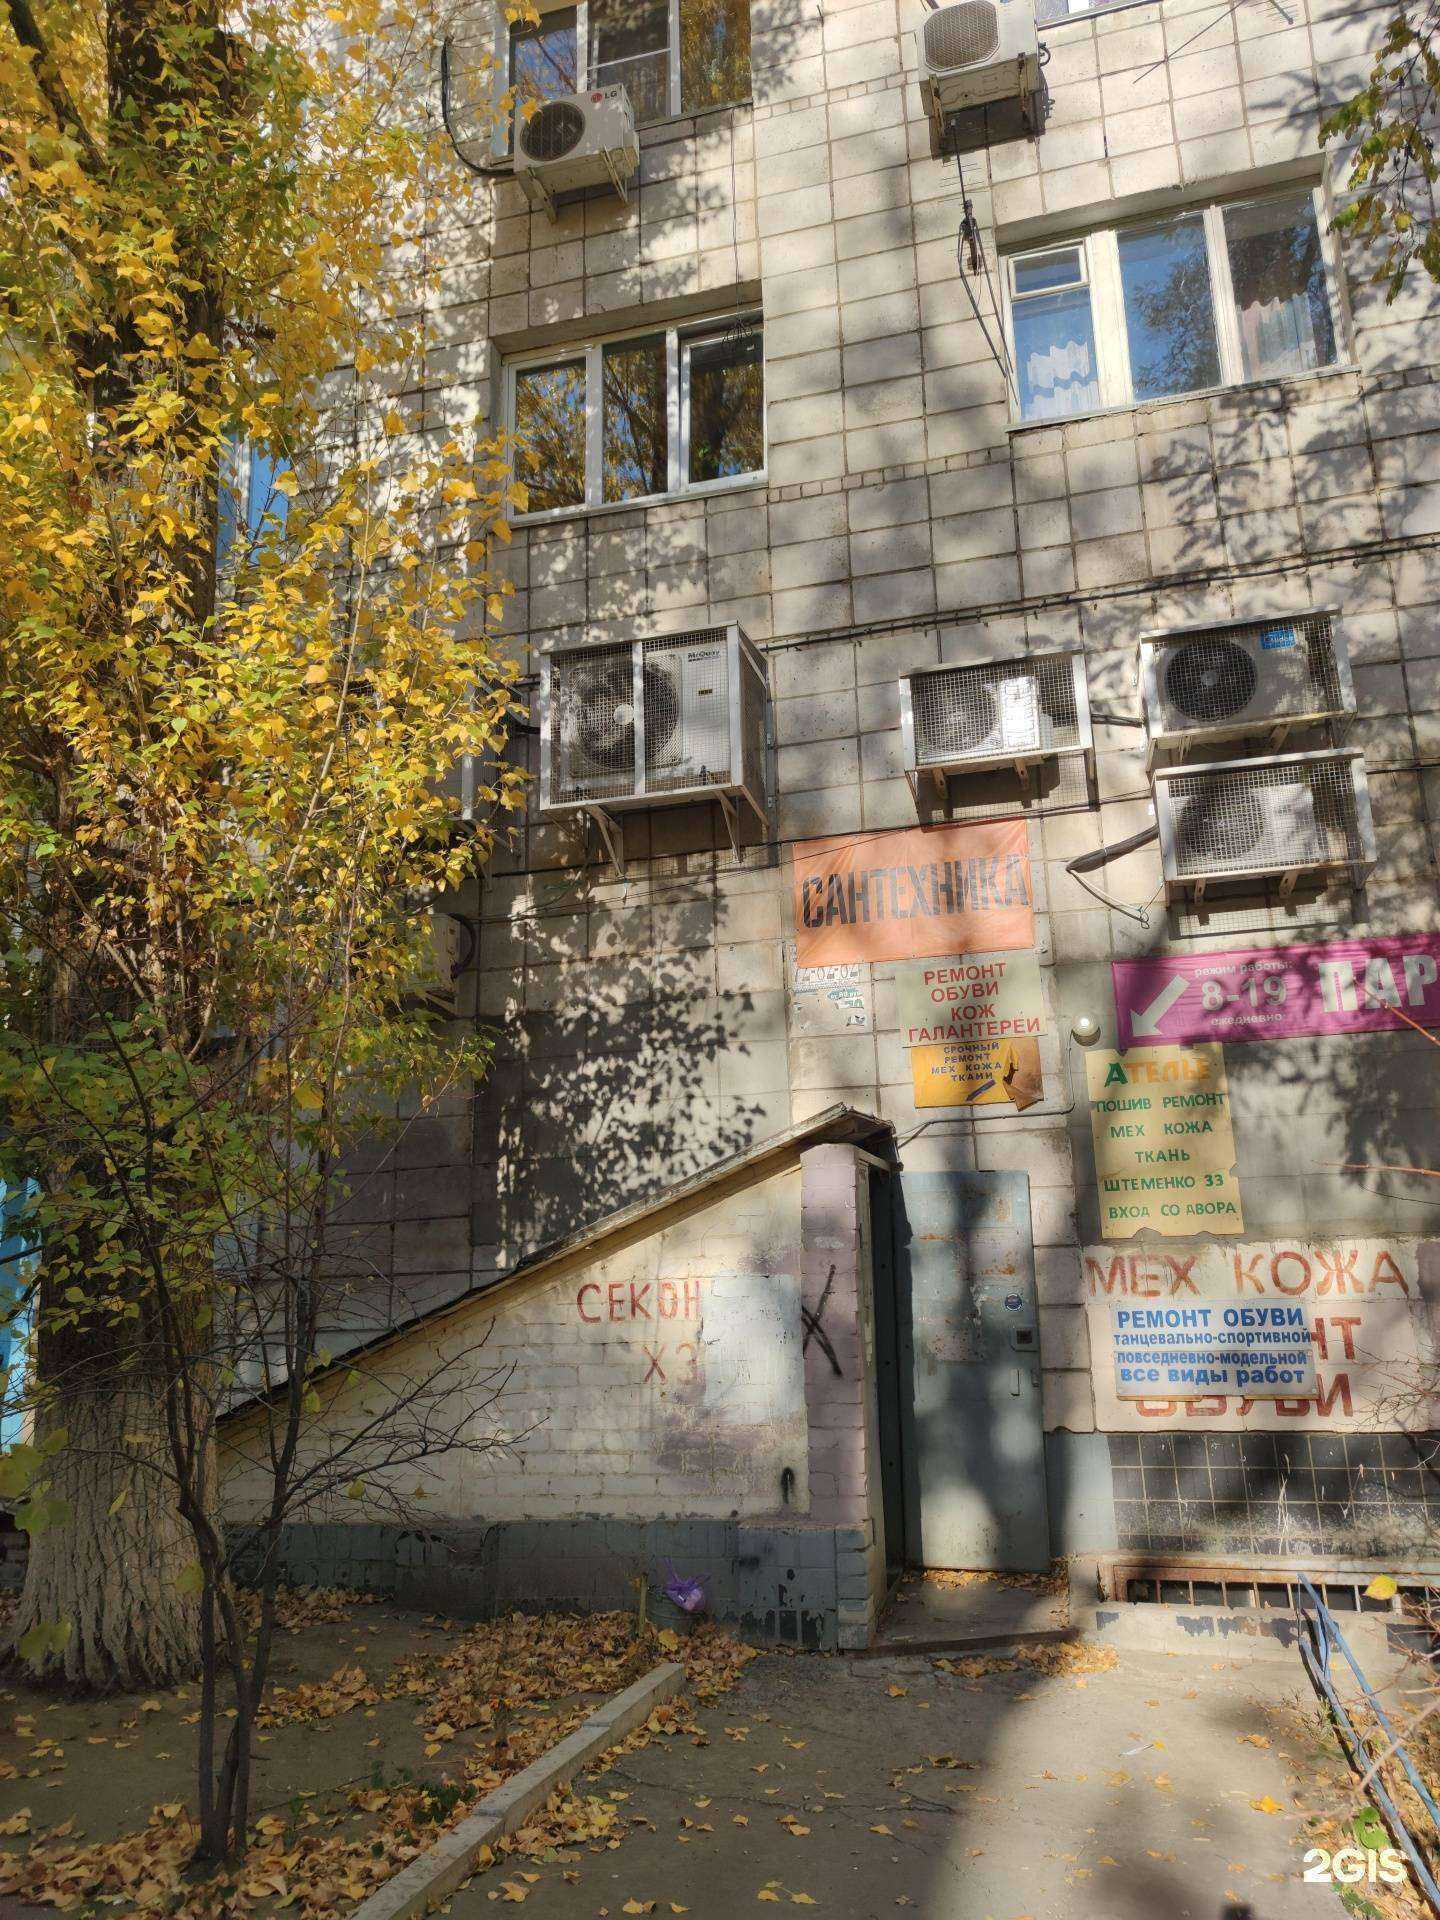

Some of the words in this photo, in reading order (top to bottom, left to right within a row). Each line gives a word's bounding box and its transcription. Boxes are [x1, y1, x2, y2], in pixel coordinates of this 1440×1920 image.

[604, 90, 618, 99] LG
[802, 853, 1028, 929] САНТЕХНИКА
[924, 962, 1006, 985] РЕМОНТ
[1318, 954, 1438, 1013] ПАР
[930, 981, 999, 1002] ОБУВИ
[1201, 975, 1287, 1011] 8-19
[951, 1003, 996, 1021] КОЖ
[1211, 1013, 1283, 1026] ежедневно
[908, 1018, 1041, 1042] ГАЛАНТЕРЕИ
[943, 1041, 1000, 1054] СРОЧНЫЙ
[931, 1064, 956, 1075] МЕХ
[965, 1061, 1002, 1072] КОЖА
[944, 1053, 991, 1063] РЕМОНТ
[951, 1071, 993, 1082] ТКАНИ
[1104, 1058, 1210, 1087] АТЕЛЬЕ
[1095, 1097, 1152, 1113] ПОШИВ
[1162, 1092, 1225, 1109] РЕМОНТ
[1110, 1123, 1146, 1138] МЕХ
[1163, 1120, 1213, 1135] КОЖА
[1135, 1147, 1191, 1163] ТКАНЬ
[1104, 1175, 1196, 1192] ШТЕМЕНКО
[1203, 1173, 1224, 1187] 33
[1160, 1203, 1181, 1216] СО
[1085, 1254, 1201, 1298] МЕХ
[1232, 1249, 1409, 1297] КОЖА
[576, 1280, 702, 1323] СЕКОН
[1117, 1308, 1212, 1329] РЕМОНТ
[1223, 1307, 1305, 1327] ОБУВИ
[1113, 1328, 1311, 1348] танцевально-спортивной
[1117, 1350, 1307, 1367] повседневно-модельной
[1119, 1367, 1160, 1382] все
[1168, 1367, 1228, 1386] виды
[1236, 1365, 1305, 1387] работ
